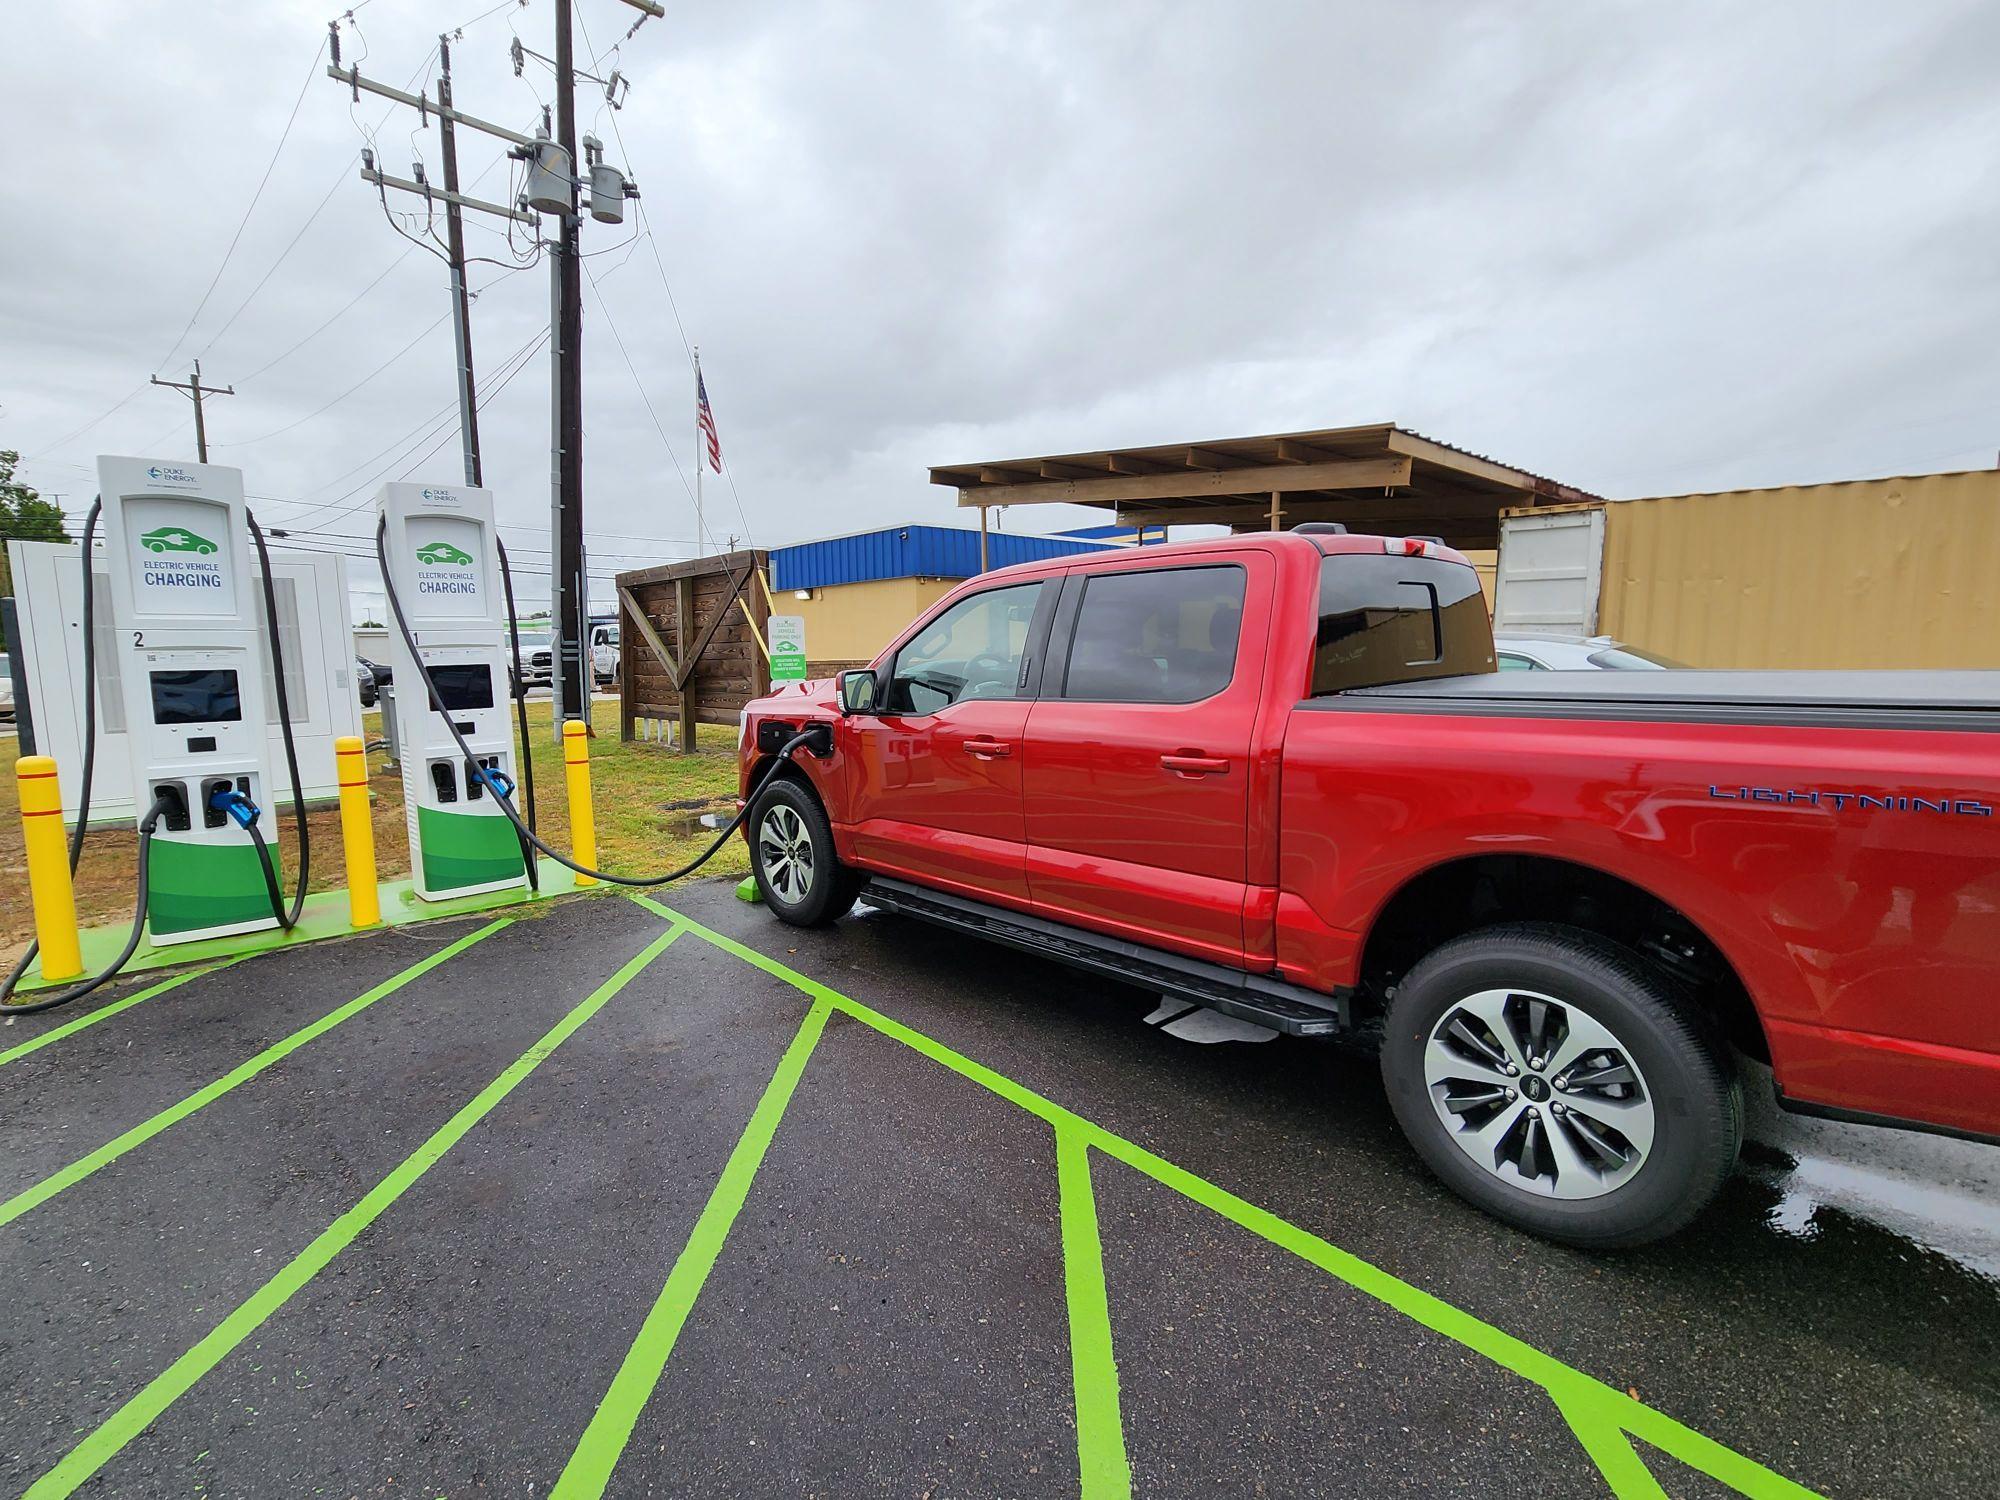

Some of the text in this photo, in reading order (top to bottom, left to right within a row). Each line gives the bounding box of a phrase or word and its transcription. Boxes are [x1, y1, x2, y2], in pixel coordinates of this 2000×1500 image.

[144, 561, 219, 571] ELECTRIC VEHICLE
[145, 572, 221, 588] CHARGING
[419, 582, 476, 594] CHARGING
[133, 632, 144, 647] 2
[1709, 785, 1992, 816] LIGHTNING
